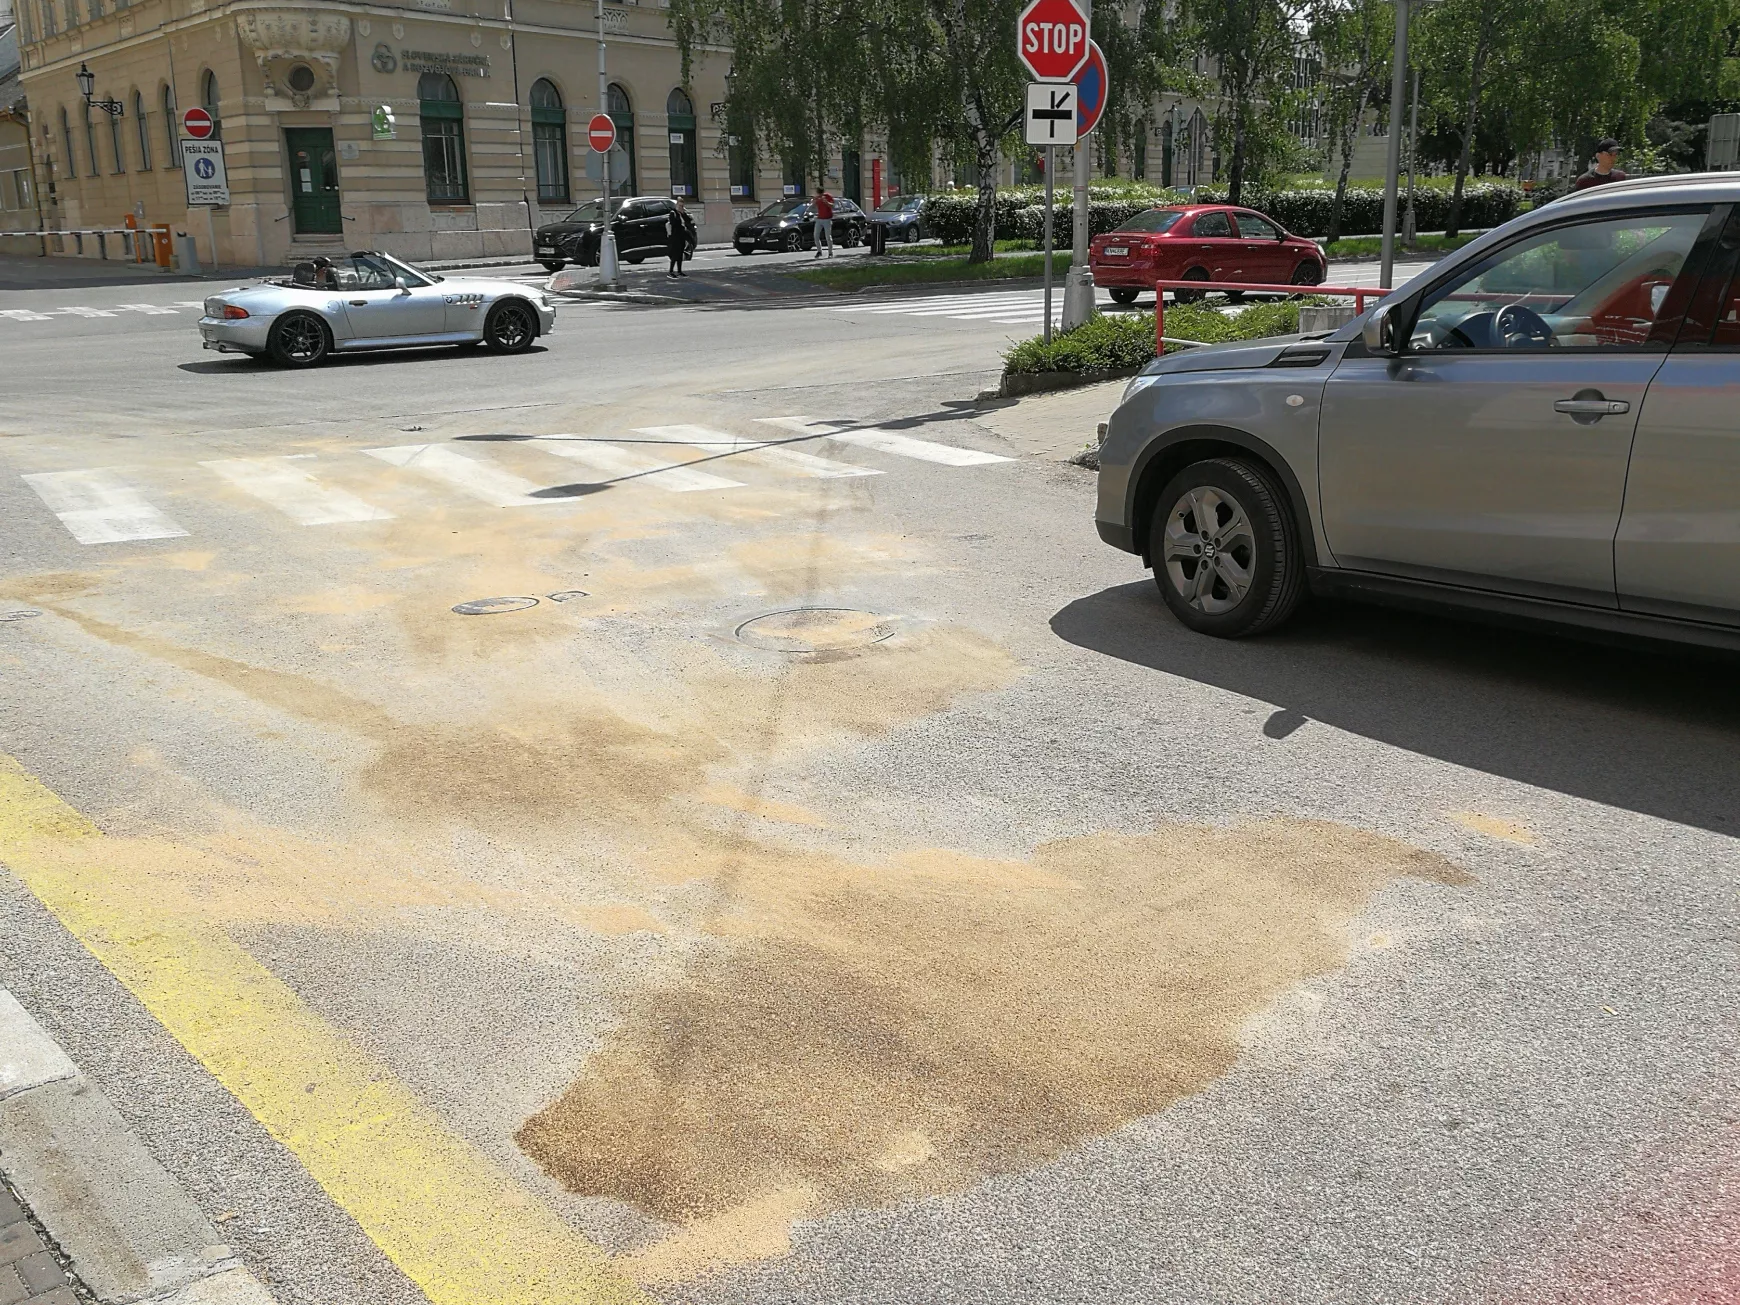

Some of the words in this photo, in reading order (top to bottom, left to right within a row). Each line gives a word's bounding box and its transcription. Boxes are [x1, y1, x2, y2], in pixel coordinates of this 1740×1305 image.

[1026, 22, 1083, 54] STOP
[185, 144, 202, 153] PEŠIA
[202, 144, 218, 153] ZÓNA
